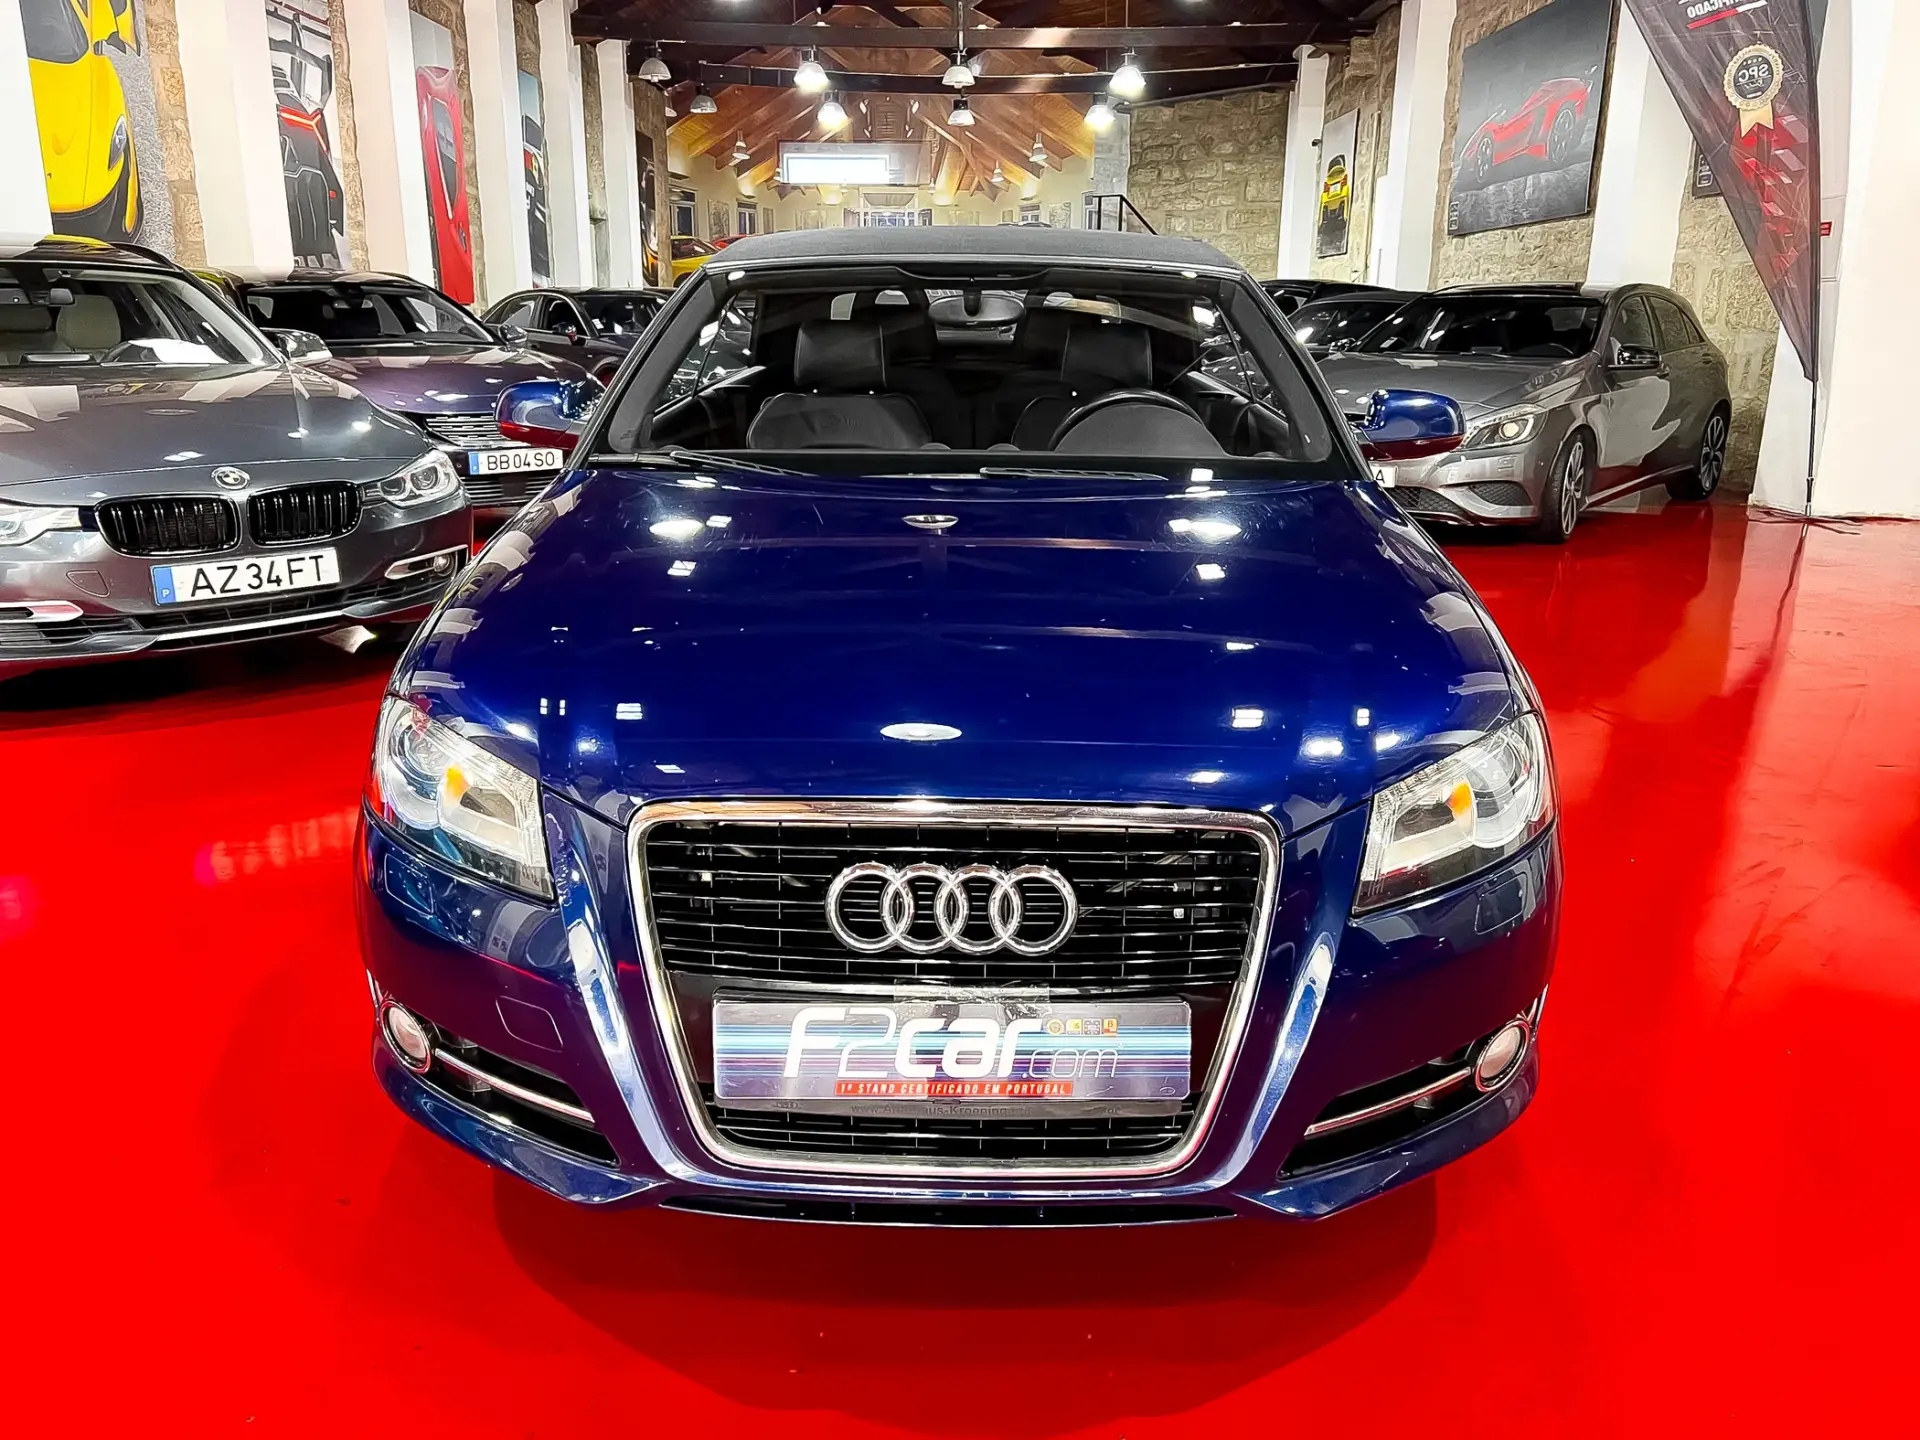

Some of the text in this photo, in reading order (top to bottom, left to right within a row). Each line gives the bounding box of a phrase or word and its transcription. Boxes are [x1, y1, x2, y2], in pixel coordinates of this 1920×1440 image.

[858, 1083, 896, 1094] STAND
[901, 1083, 979, 1094] CERTIFICADO
[984, 1083, 1000, 1094] EM
[1005, 1083, 1066, 1094] PORTUGAL
